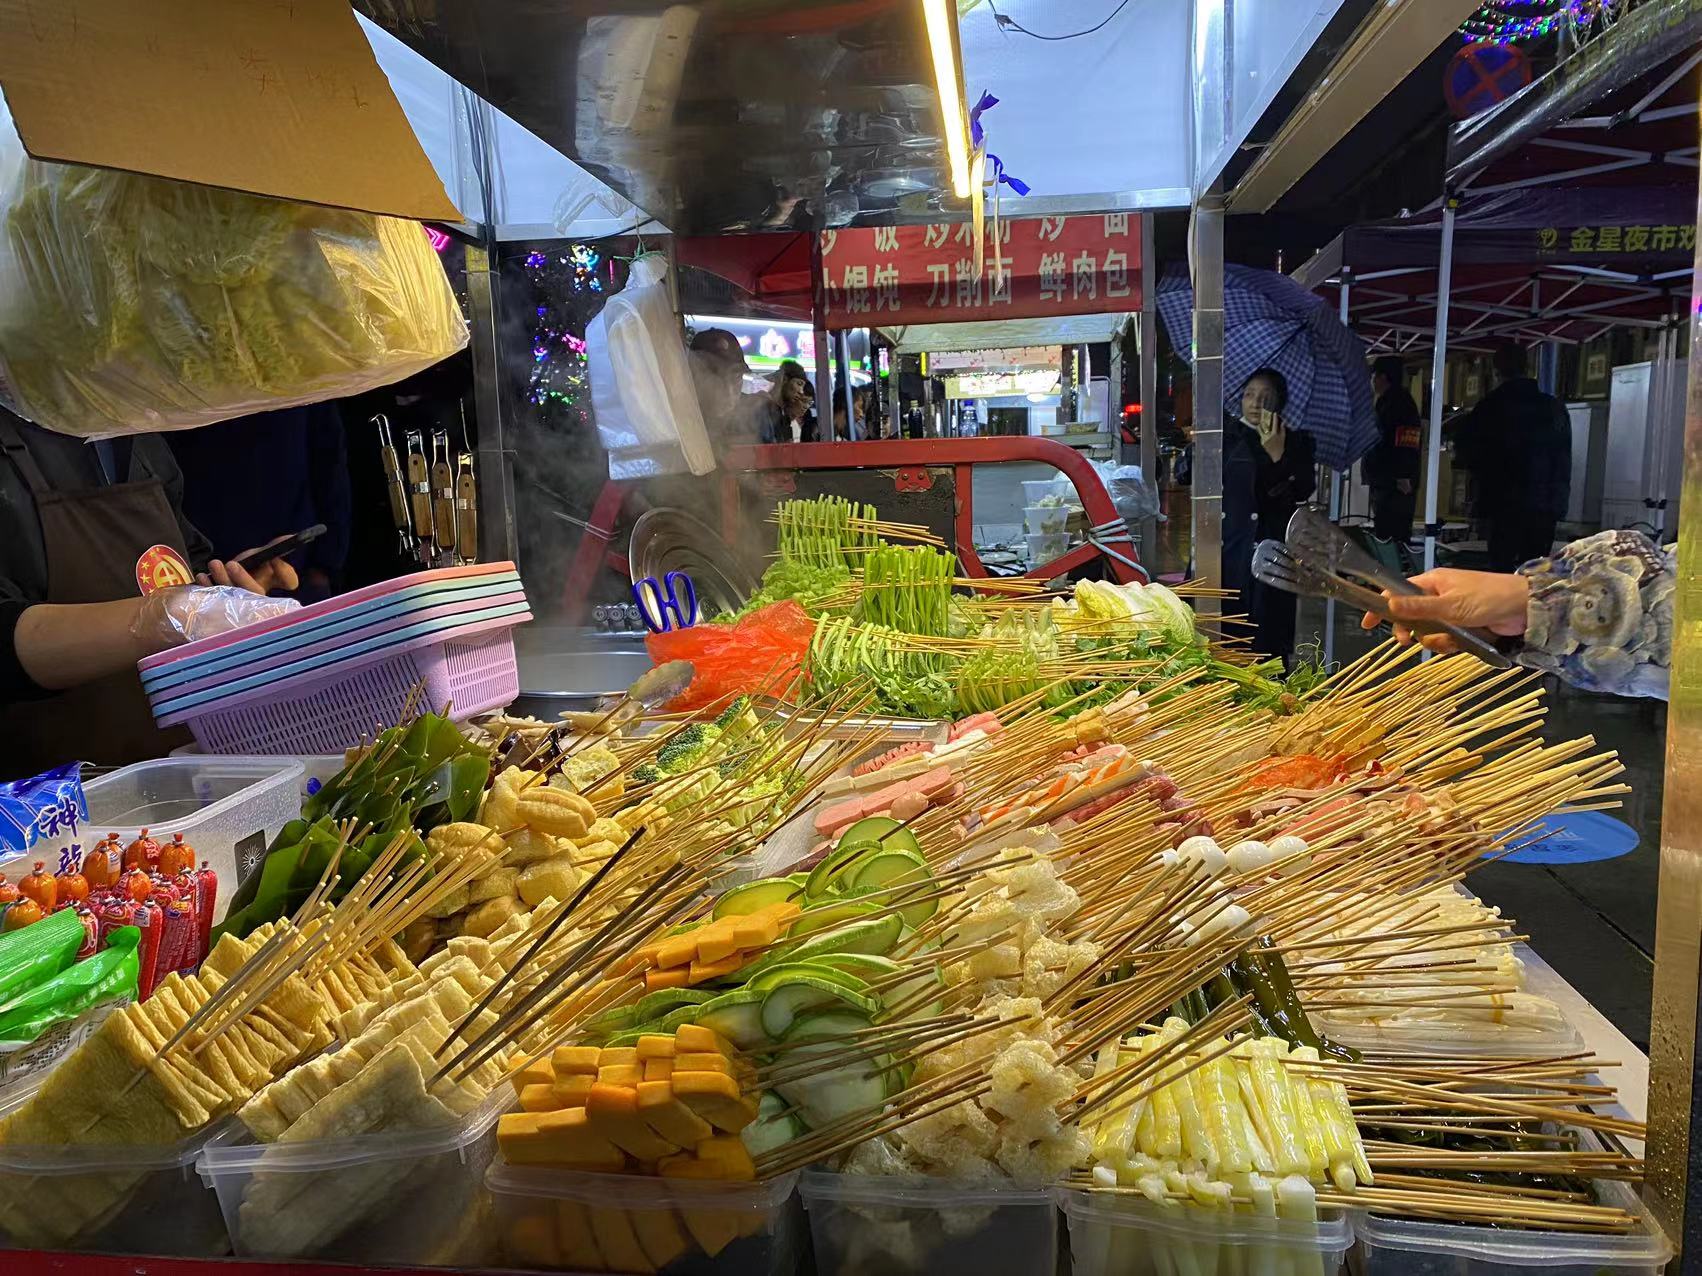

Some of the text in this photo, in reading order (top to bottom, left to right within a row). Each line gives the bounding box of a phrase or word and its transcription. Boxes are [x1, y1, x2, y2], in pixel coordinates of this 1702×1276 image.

[817, 248, 1131, 316] 小馄饨 刀削面 鲜肉包
